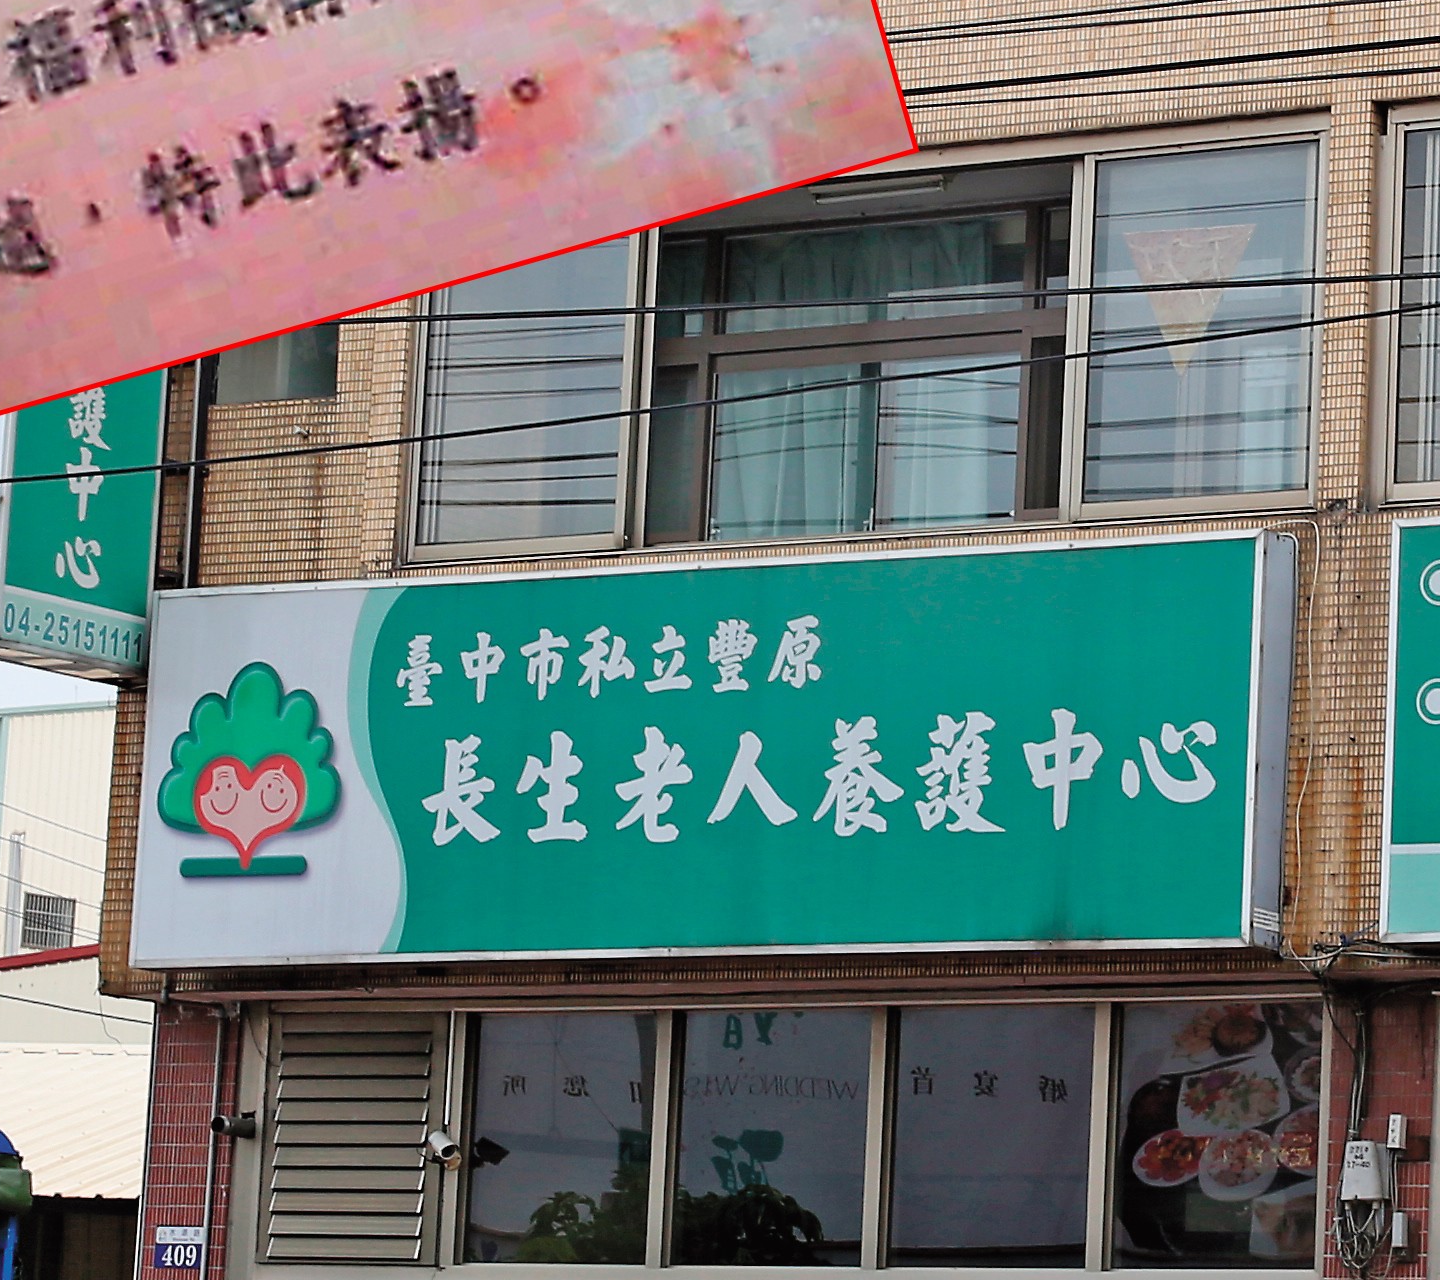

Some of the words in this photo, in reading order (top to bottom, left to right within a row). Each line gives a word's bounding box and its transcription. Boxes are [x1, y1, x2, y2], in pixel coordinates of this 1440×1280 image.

[2, 602, 143, 664] 04-25151111
[394, 613, 824, 708] 臺中市私立豐原
[420, 706, 1219, 847] 長生老人養護中心
[161, 1244, 197, 1267] 409
